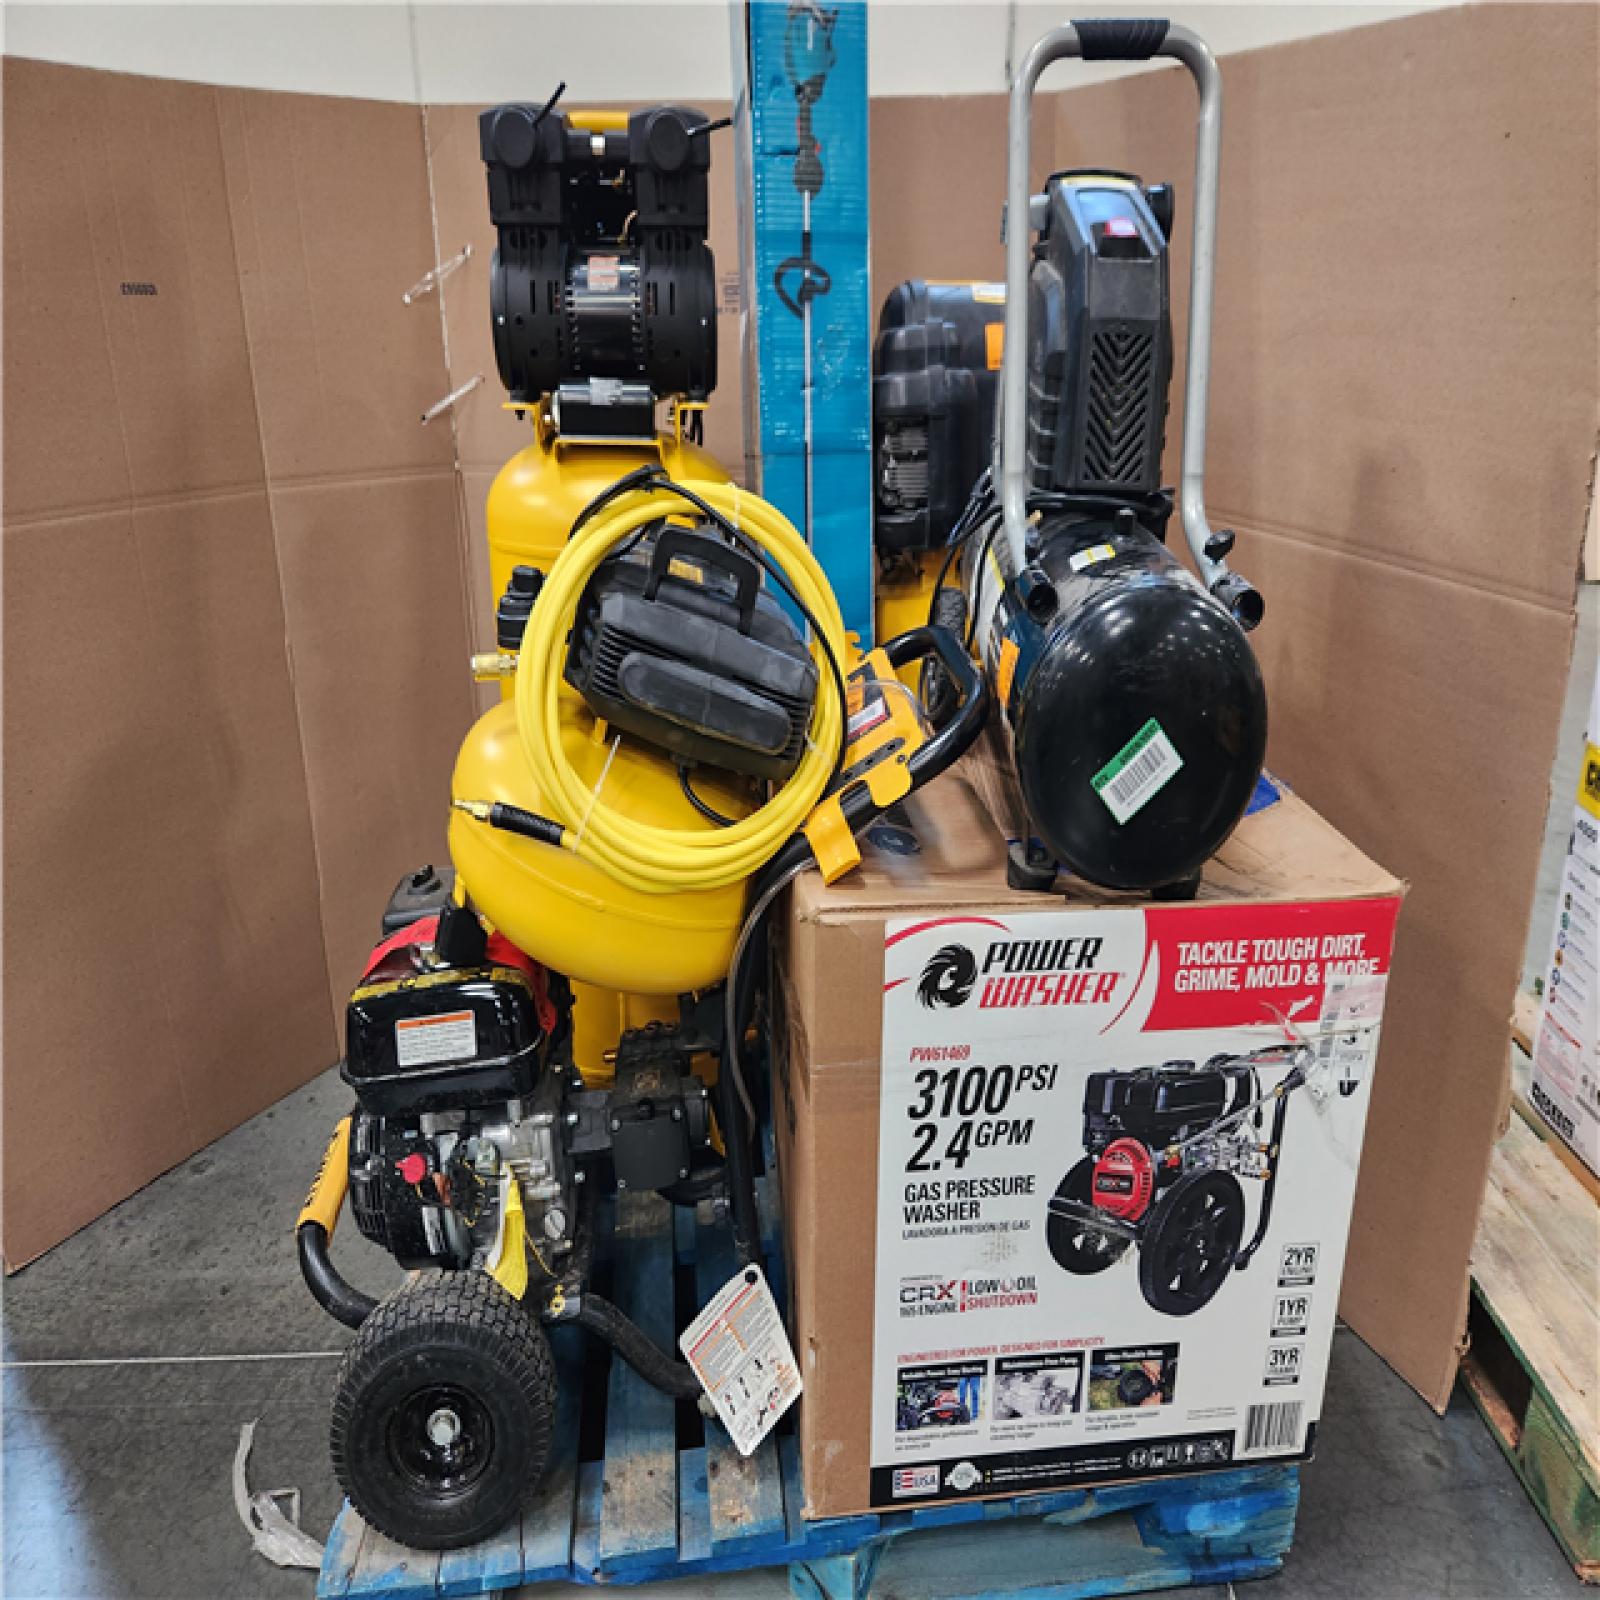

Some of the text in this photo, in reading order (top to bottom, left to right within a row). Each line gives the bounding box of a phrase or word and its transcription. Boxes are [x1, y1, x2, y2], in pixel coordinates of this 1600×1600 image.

[982, 937, 1103, 974] POWER
[1177, 933, 1366, 966] TACKLE TOUGH DIRT,
[979, 972, 1121, 1009] WASHER
[1174, 967, 1240, 993] GRIME,
[1245, 964, 1301, 988] MOLD
[1304, 962, 1321, 985] &
[907, 1064, 1059, 1120] 3100 PSI
[905, 1118, 1035, 1173] 2.4 GPM
[904, 1175, 1036, 1203] GAS PRESSURE
[902, 1200, 981, 1225] WASHER
[1285, 1247, 1316, 1265] 2YR
[900, 1280, 957, 1303] CRX
[969, 1276, 1036, 1295] LOW OIL
[968, 1292, 1038, 1310] SHUTDOWN
[1279, 1298, 1307, 1316] 1YR
